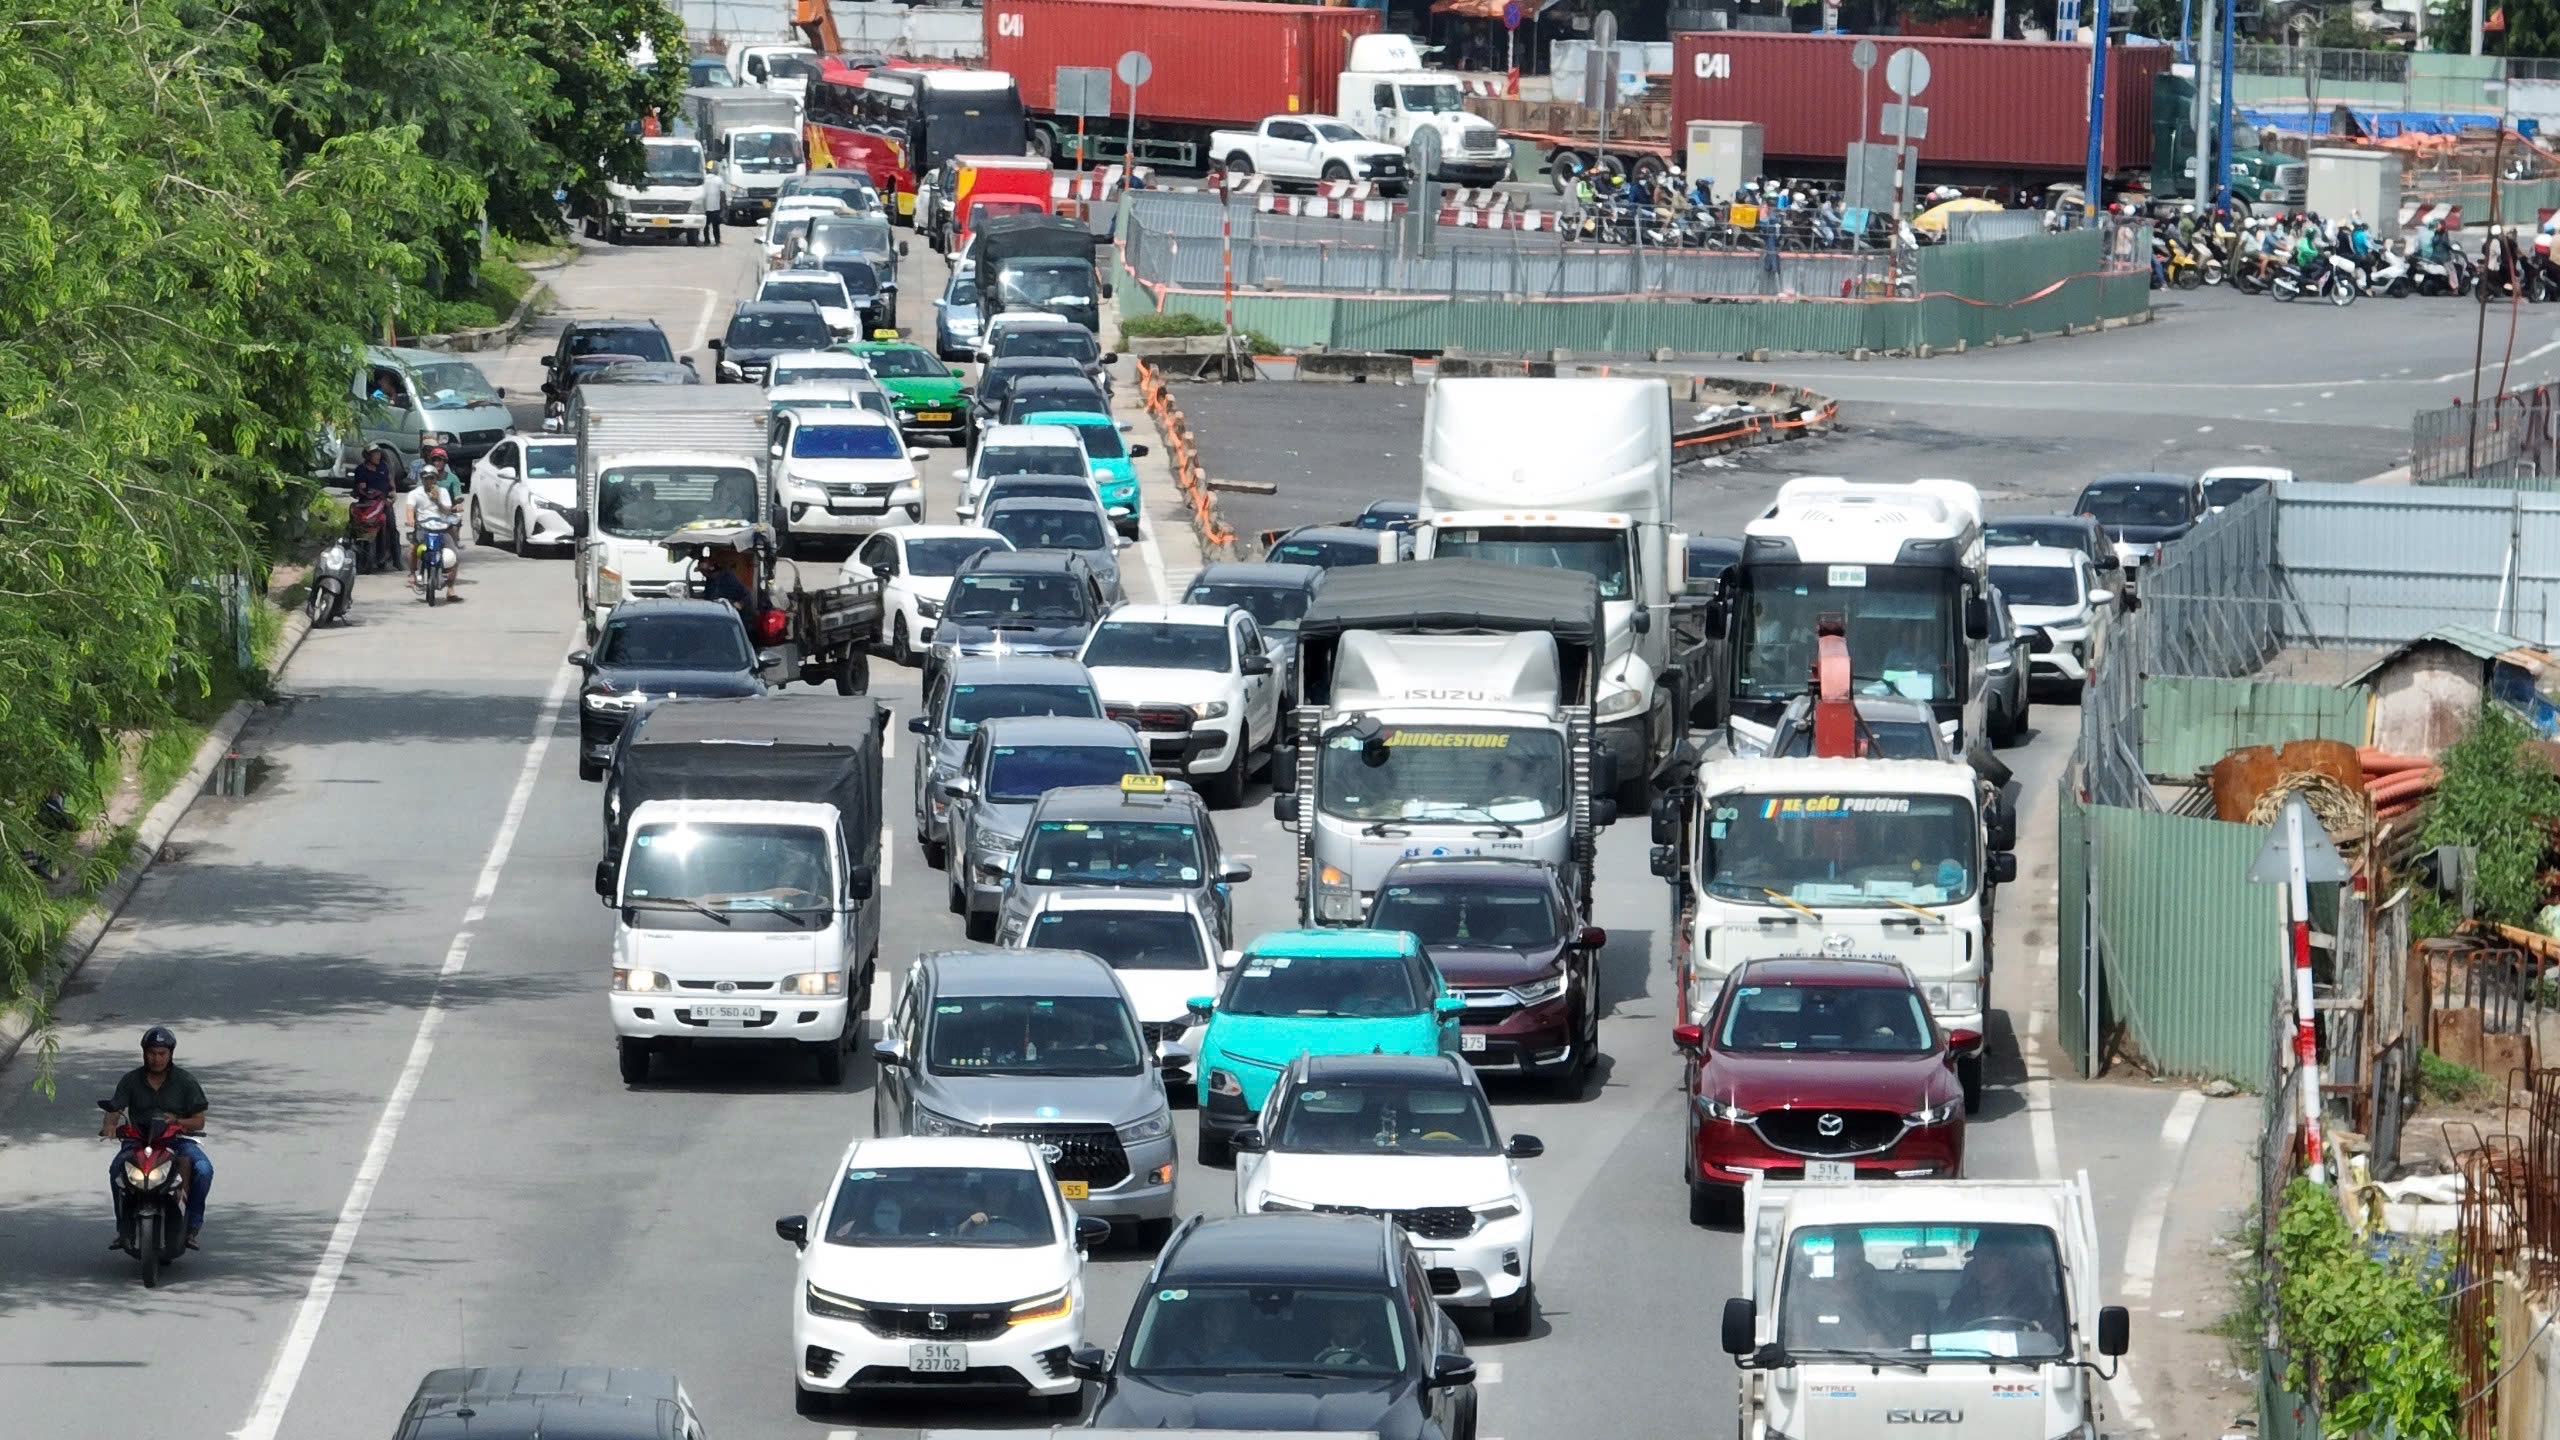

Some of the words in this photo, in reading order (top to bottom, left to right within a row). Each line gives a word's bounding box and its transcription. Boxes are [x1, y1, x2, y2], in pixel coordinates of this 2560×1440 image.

[998, 13, 1024, 37] CAI
[1694, 53, 1730, 78] CAI
[1404, 689, 1484, 701] ISUZU
[1383, 730, 1510, 748] BRIDGESTONE
[1782, 799, 1801, 811] XE
[1819, 1163, 1840, 1175] 51K
[926, 1345, 950, 1358] 51K
[916, 1358, 961, 1371] 237.02
[1886, 1407, 1964, 1425] ISUZU
